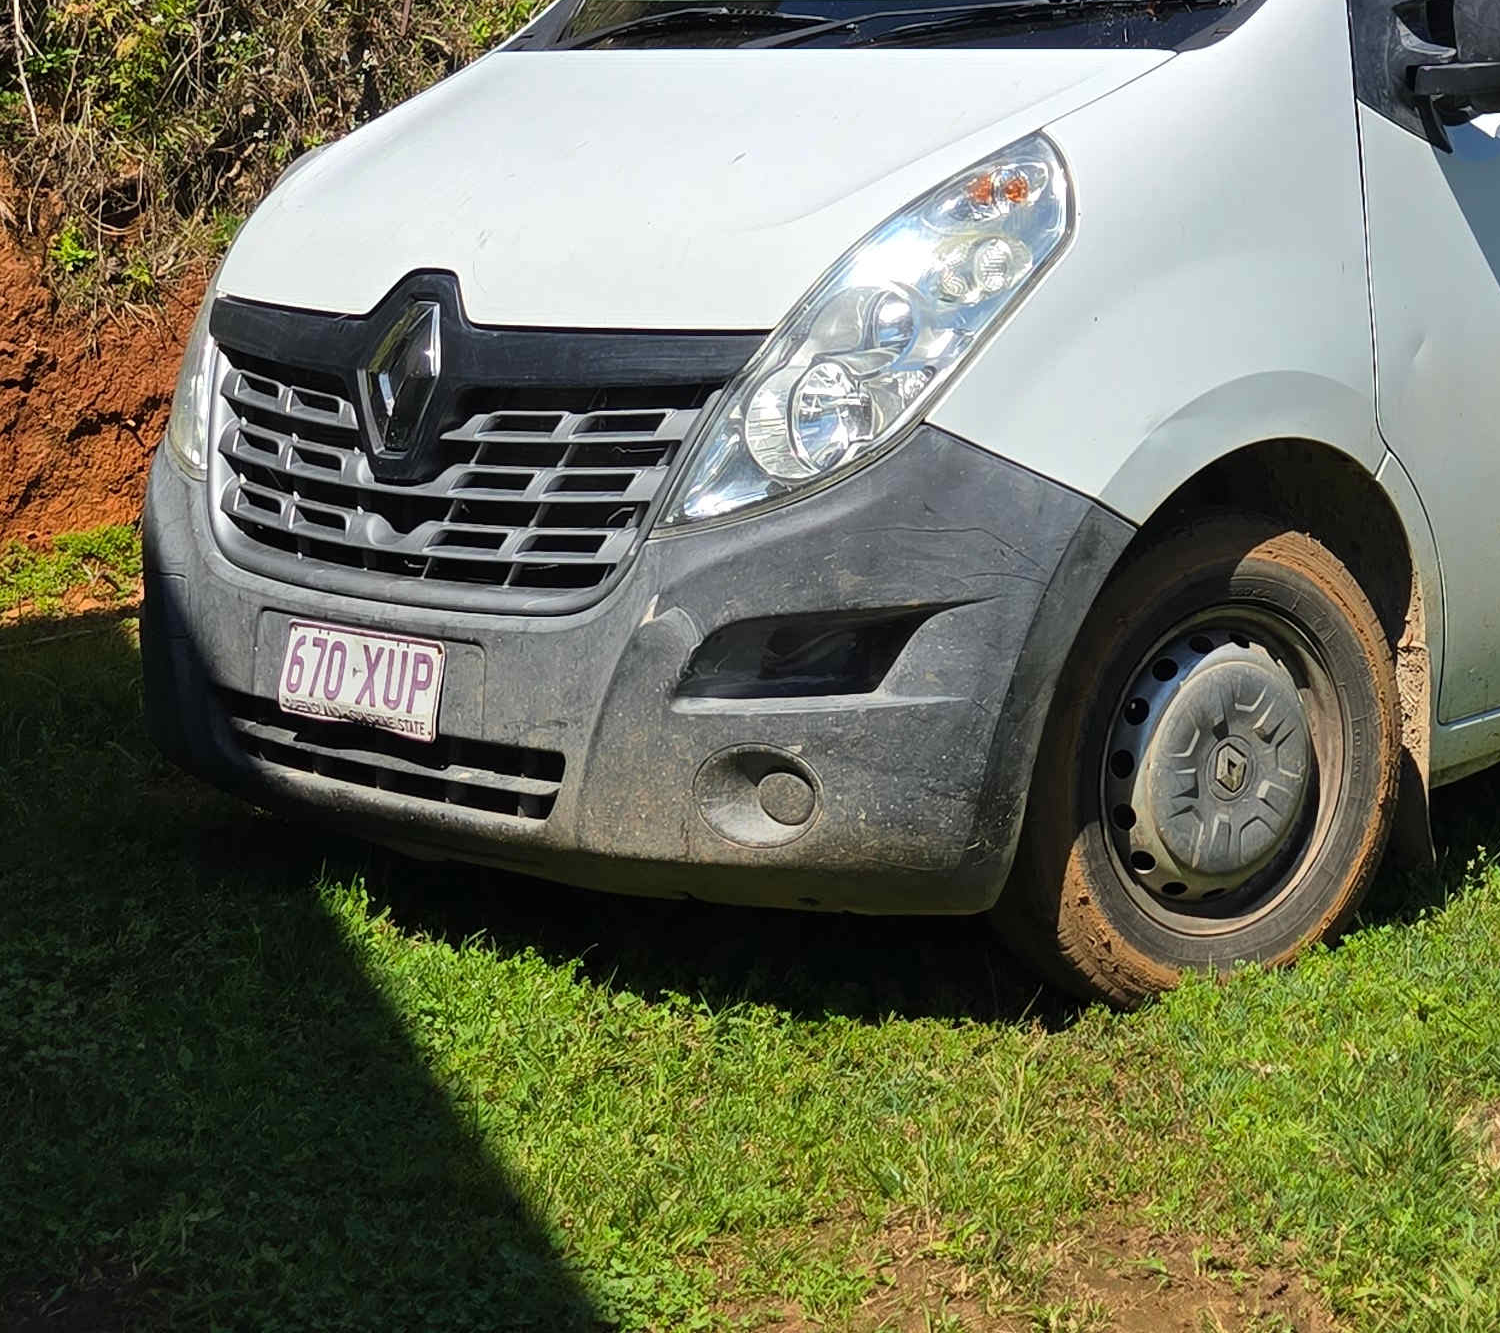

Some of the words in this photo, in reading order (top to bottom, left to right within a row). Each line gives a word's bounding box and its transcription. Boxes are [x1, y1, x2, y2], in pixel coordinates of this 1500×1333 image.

[286, 635, 347, 701] 670
[354, 644, 433, 714] XUP
[399, 719, 425, 736] STATE
